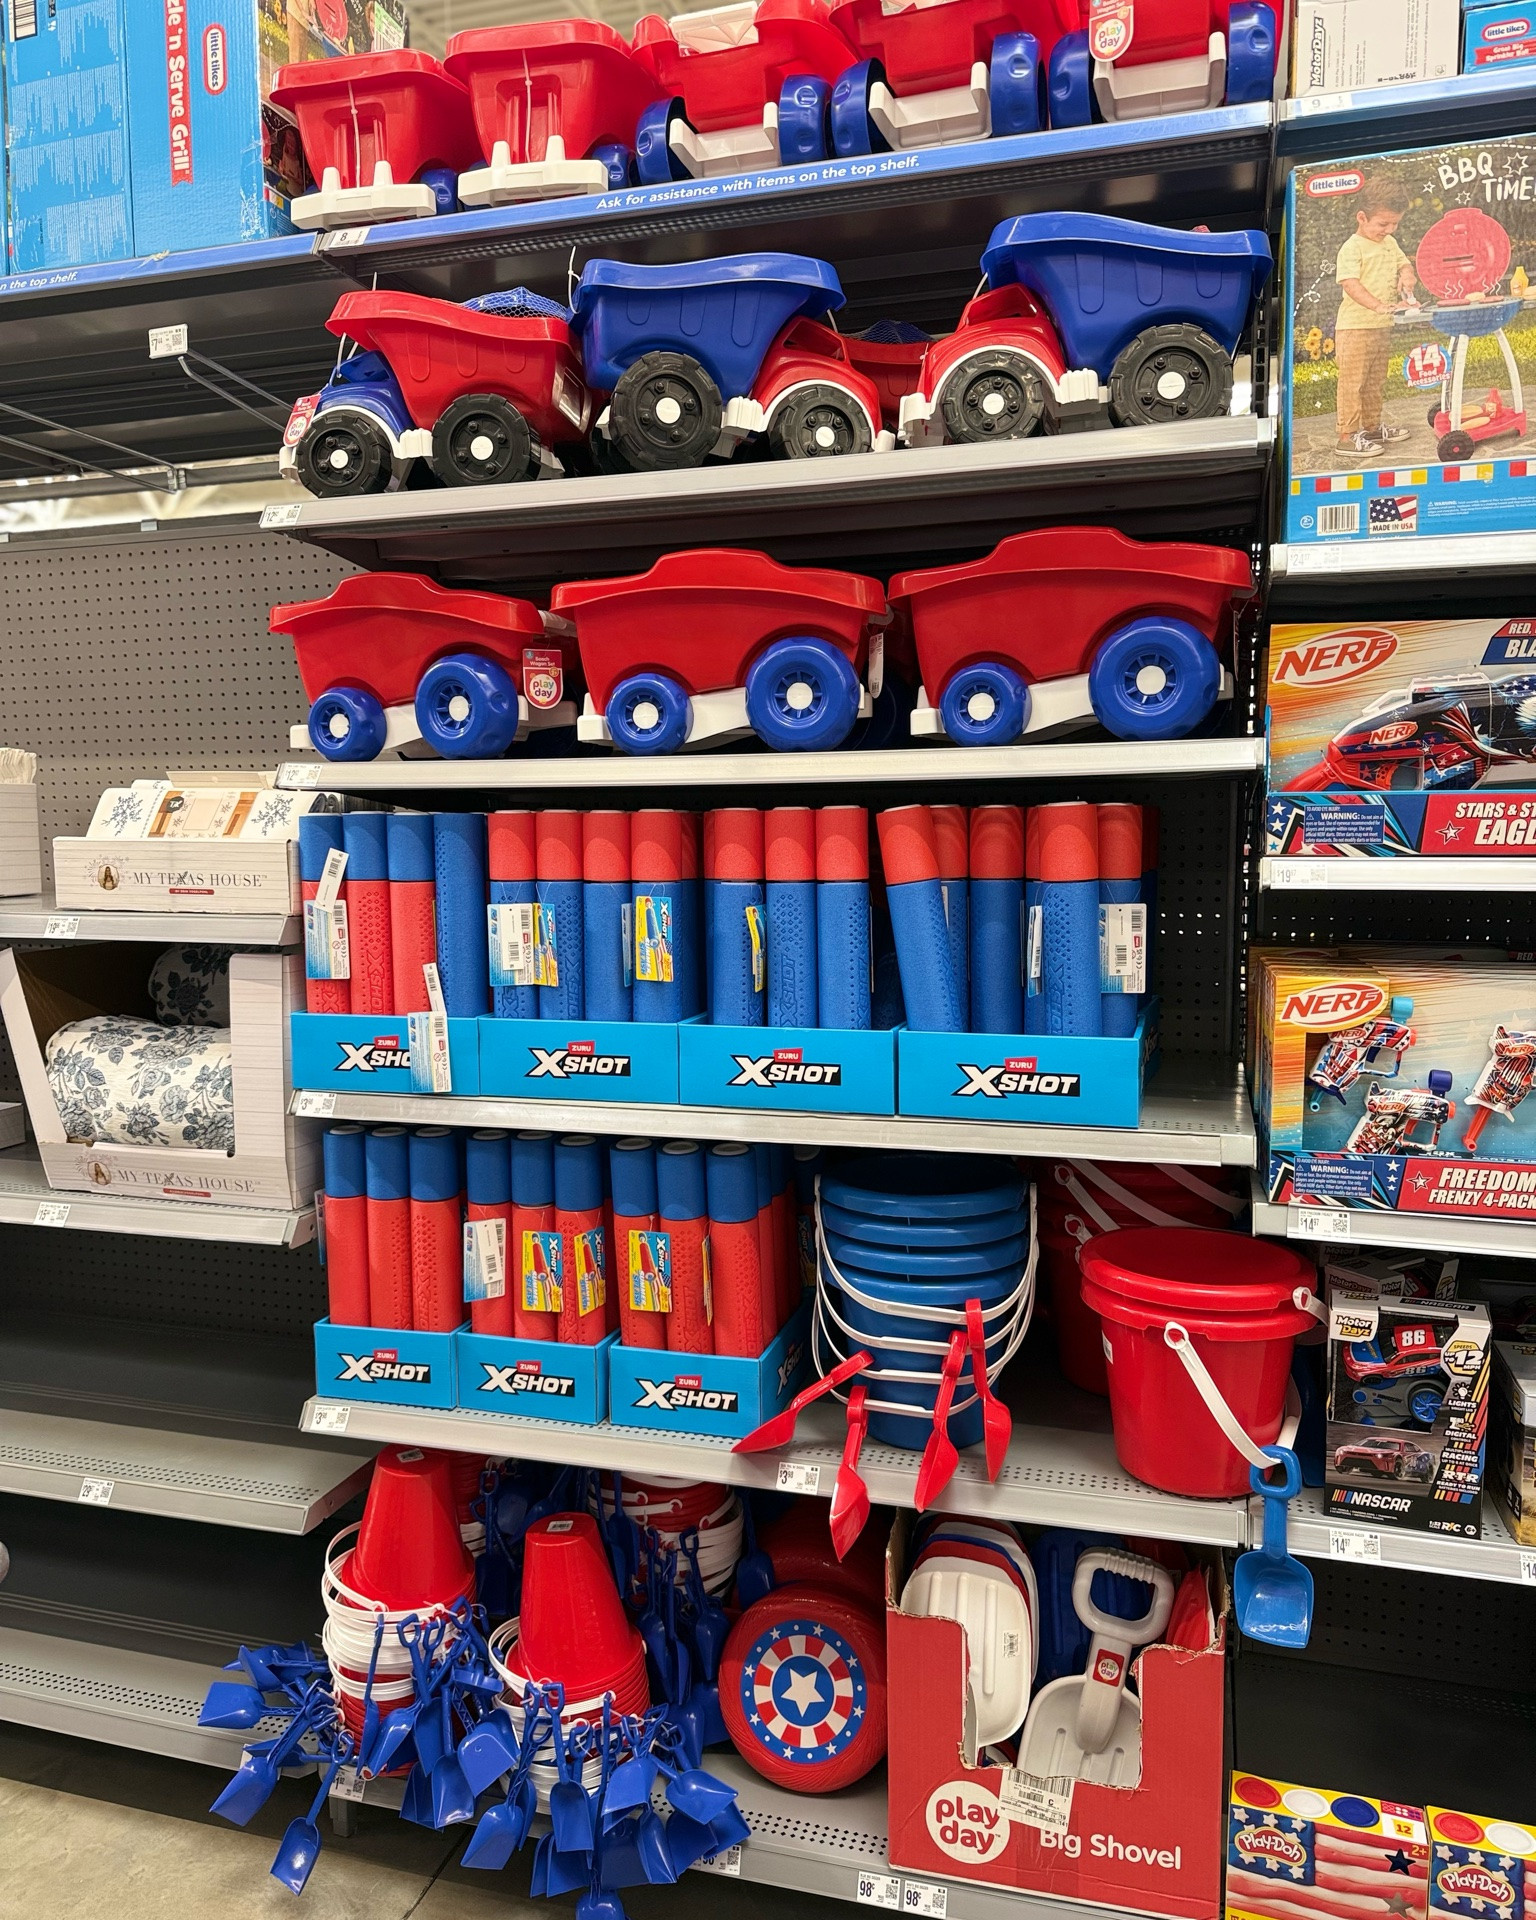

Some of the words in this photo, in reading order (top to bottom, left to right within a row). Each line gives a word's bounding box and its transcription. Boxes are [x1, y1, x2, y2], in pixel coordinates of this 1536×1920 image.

[1098, 24, 1122, 42] play
[1487, 27, 1505, 37] little
[1506, 25, 1525, 34] tikes
[210, 31, 220, 59] little
[1100, 36, 1120, 49] day
[1311, 17, 1325, 87] MotorDayz
[211, 60, 220, 88] tikes
[168, 55, 186, 118] Serve
[171, 123, 190, 171] Grill
[1437, 152, 1494, 190] BBQ
[596, 197, 623, 209] Ask
[625, 193, 647, 206] for
[649, 183, 719, 202] assistance
[721, 178, 752, 193] with
[756, 174, 795, 189] items
[799, 171, 818, 182] on
[822, 166, 846, 178] the
[850, 163, 876, 177] top
[879, 155, 920, 172] shelf.
[1312, 179, 1335, 191] little
[1335, 177, 1358, 188] tikes
[9, 279, 27, 289] the
[29, 277, 48, 289] top
[49, 271, 78, 284] shelf.
[1409, 343, 1442, 371] 14
[1407, 373, 1451, 387] Accessories
[1418, 367, 1438, 378] Food
[1372, 524, 1391, 532] MADE
[1392, 523, 1400, 531] IN
[1401, 522, 1414, 530] USA
[1508, 622, 1532, 635] RED,
[1275, 633, 1396, 681] NERF
[533, 680, 554, 690] play
[535, 688, 553, 699] day
[1369, 724, 1417, 744] NERF
[1321, 812, 1360, 820] WARNING:
[1455, 802, 1506, 818] STARS
[1507, 804, 1517, 816] &
[133, 872, 156, 885] MY
[158, 871, 204, 886] TEXAS
[210, 873, 262, 888] HOUSE
[660, 901, 669, 939] XSHOT
[1282, 987, 1384, 1021] NERF
[527, 1049, 630, 1078] XSHOT
[778, 1052, 799, 1060] ZURU
[1009, 1061, 1033, 1069] ZURU
[729, 1055, 841, 1087] XSHOT
[954, 1064, 1079, 1098] XSHOT
[1375, 1103, 1406, 1112] NERF
[1310, 1164, 1349, 1174] WARNING:
[118, 1169, 138, 1182] MY
[143, 1171, 194, 1188] TEXAS
[199, 1176, 255, 1193] HOUSE
[1438, 1167, 1536, 1193] FREEDOM
[1428, 1189, 1484, 1206] FRENZY
[549, 1237, 558, 1272] XSHOT
[595, 1232, 603, 1268] XSHOT
[656, 1236, 666, 1273] XSHOT
[639, 1270, 647, 1305] SUMMER
[1420, 1300, 1470, 1310] NASCAR
[1336, 1316, 1372, 1328] Motor
[1340, 1326, 1372, 1336] Dayz
[1401, 1329, 1426, 1347] 86
[376, 1352, 395, 1360] ZURU
[1454, 1350, 1484, 1366] 12
[337, 1353, 431, 1383] XSHOT
[520, 1362, 538, 1372] ZURU
[480, 1365, 575, 1395] XSHOT
[678, 1378, 699, 1387] ZURU
[635, 1379, 738, 1411] XSHOT
[1448, 1400, 1477, 1409] LIGHTS
[1445, 1430, 1477, 1440] DIGITAL
[1442, 1451, 1478, 1463] RACING
[1351, 1491, 1412, 1512] NASCAR
[1100, 1661, 1117, 1672] play
[1101, 1668, 1115, 1678] day
[935, 1795, 1000, 1829] play
[1396, 1823, 1412, 1835] 12
[940, 1822, 996, 1856] day
[1239, 1830, 1302, 1863] Play-Doh
[1040, 1829, 1081, 1858] Big
[1090, 1833, 1182, 1870] Shovel
[1411, 1844, 1428, 1857] 2+
[1442, 1869, 1511, 1901] Play-Doh
